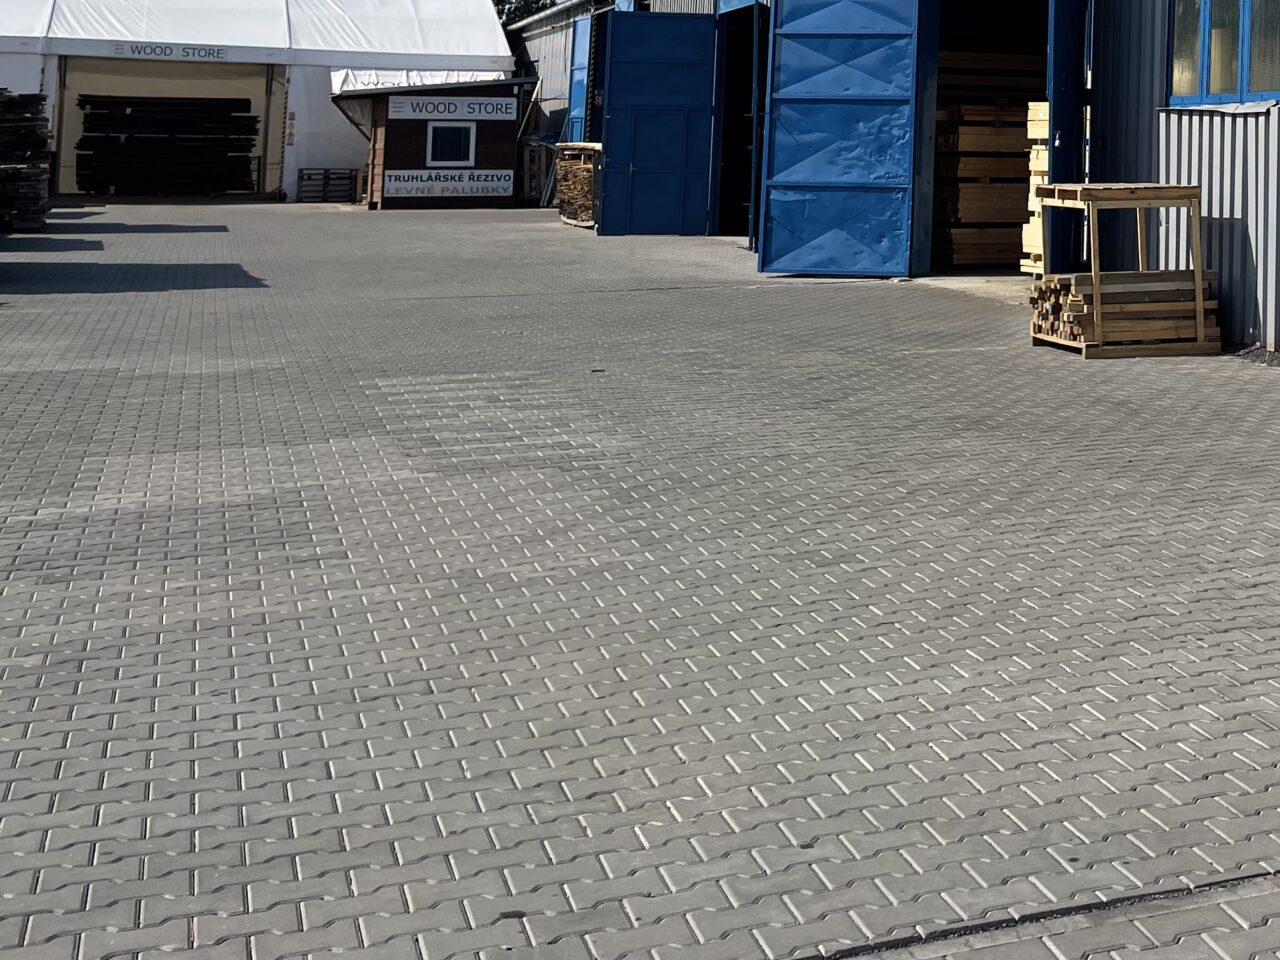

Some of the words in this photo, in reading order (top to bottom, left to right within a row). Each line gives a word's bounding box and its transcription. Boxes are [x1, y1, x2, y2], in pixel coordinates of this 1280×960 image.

[130, 44, 174, 57] WOOD
[182, 46, 225, 59] STORE
[410, 101, 458, 114] WOOD
[466, 102, 513, 115] STORE
[386, 172, 465, 183] TRUHLÁŘSKÉ
[468, 171, 512, 183] ŘEZIVO
[385, 185, 436, 196] LEVNÉ
[440, 186, 510, 195] PALUBKY
